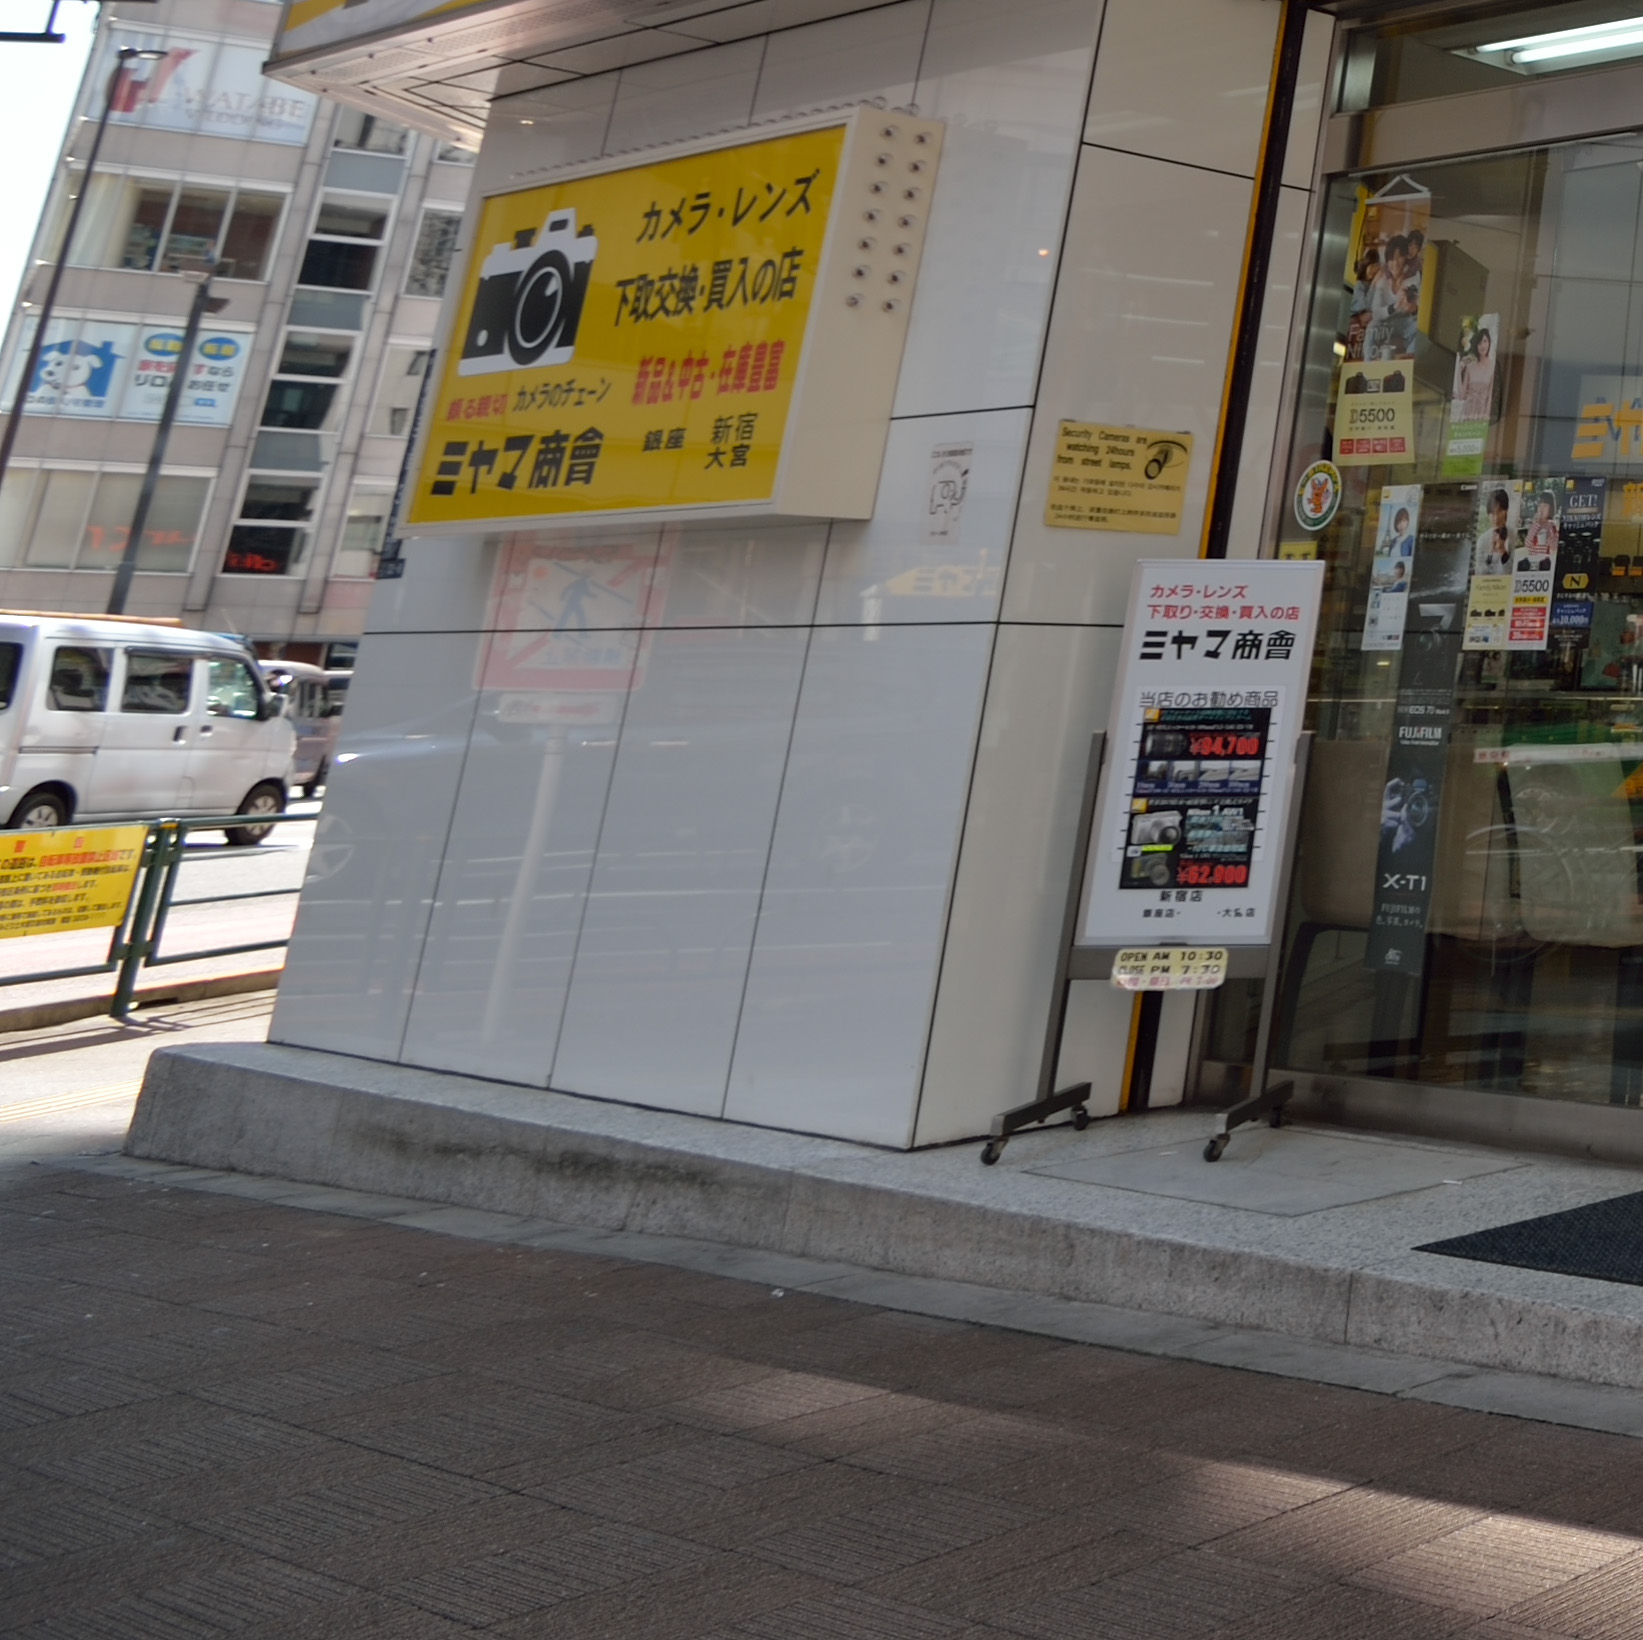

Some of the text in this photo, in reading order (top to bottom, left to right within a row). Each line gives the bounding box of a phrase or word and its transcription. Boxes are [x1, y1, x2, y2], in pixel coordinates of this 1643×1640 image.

[636, 169, 819, 244] カメラ・レンズ
[614, 248, 803, 327] 下取交換・買入の店
[513, 378, 612, 414] カメラのチェーン
[1349, 407, 1395, 424] D5500
[711, 412, 757, 444] 新宿
[642, 427, 686, 452] 銀座
[705, 444, 749, 470] 大宮
[1151, 585, 1248, 598] カメラ・レンズ
[1514, 580, 1550, 592] D5500
[1148, 605, 1300, 620] 下取り・交換・買入の店
[1399, 726, 1442, 739] FUJIFILM
[1382, 874, 1427, 891] X-T1
[1120, 952, 1147, 962] OPEN
[1152, 952, 1171, 961] AM
[1150, 965, 1171, 974] PM
